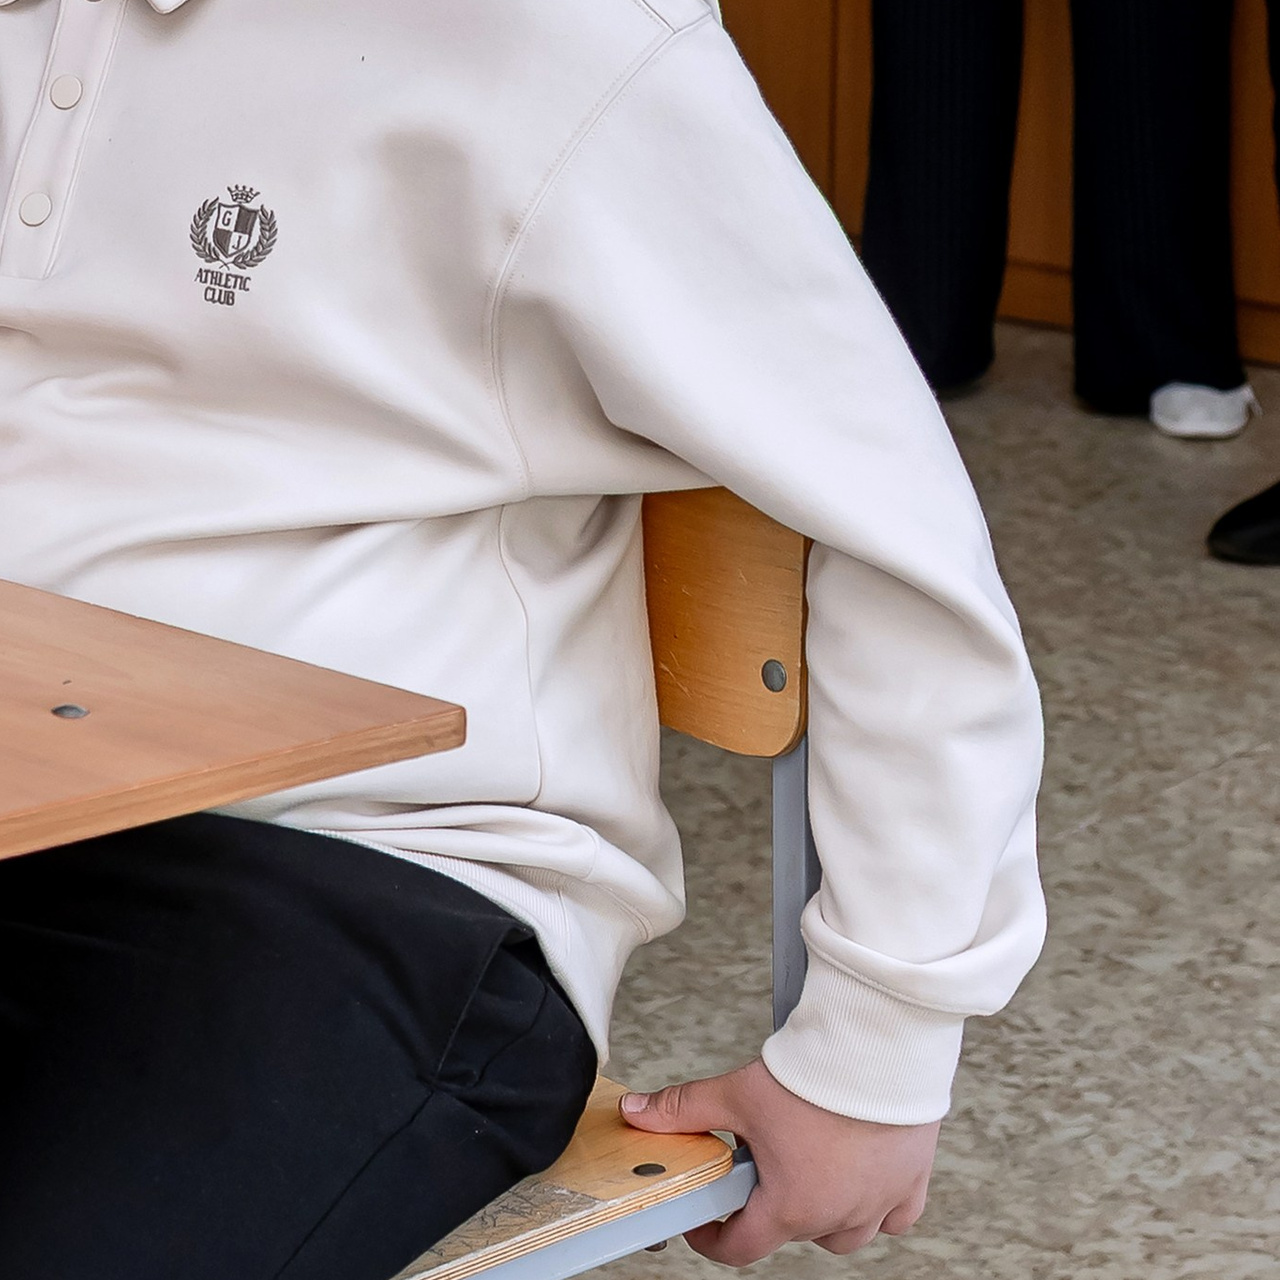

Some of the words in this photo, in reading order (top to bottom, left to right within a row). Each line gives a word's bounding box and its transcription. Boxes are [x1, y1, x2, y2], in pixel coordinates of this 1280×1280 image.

[222, 210, 232, 227] G
[194, 267, 251, 291] ATHLETIC
[204, 286, 235, 306] CLUB
